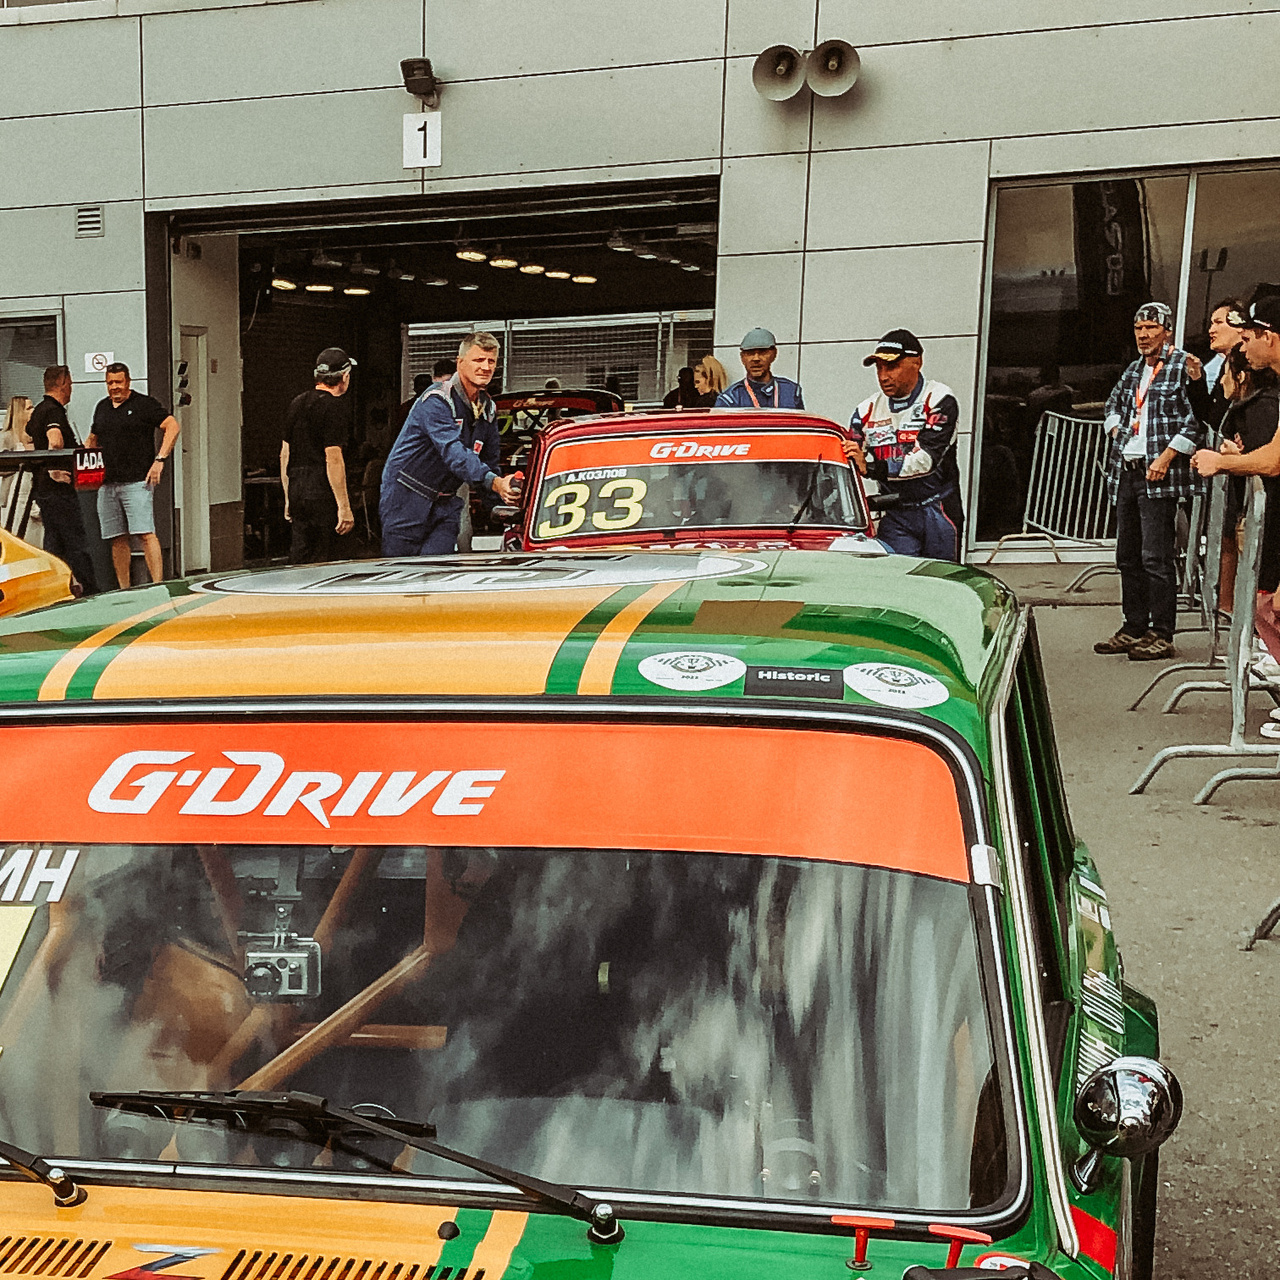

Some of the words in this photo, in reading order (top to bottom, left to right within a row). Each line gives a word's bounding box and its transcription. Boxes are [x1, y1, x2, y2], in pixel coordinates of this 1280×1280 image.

[416, 120, 428, 159] 1
[76, 451, 105, 471] LADA
[565, 467, 628, 484] А.КОЗЛОВ
[538, 477, 648, 539] 33
[757, 670, 832, 683] Historic
